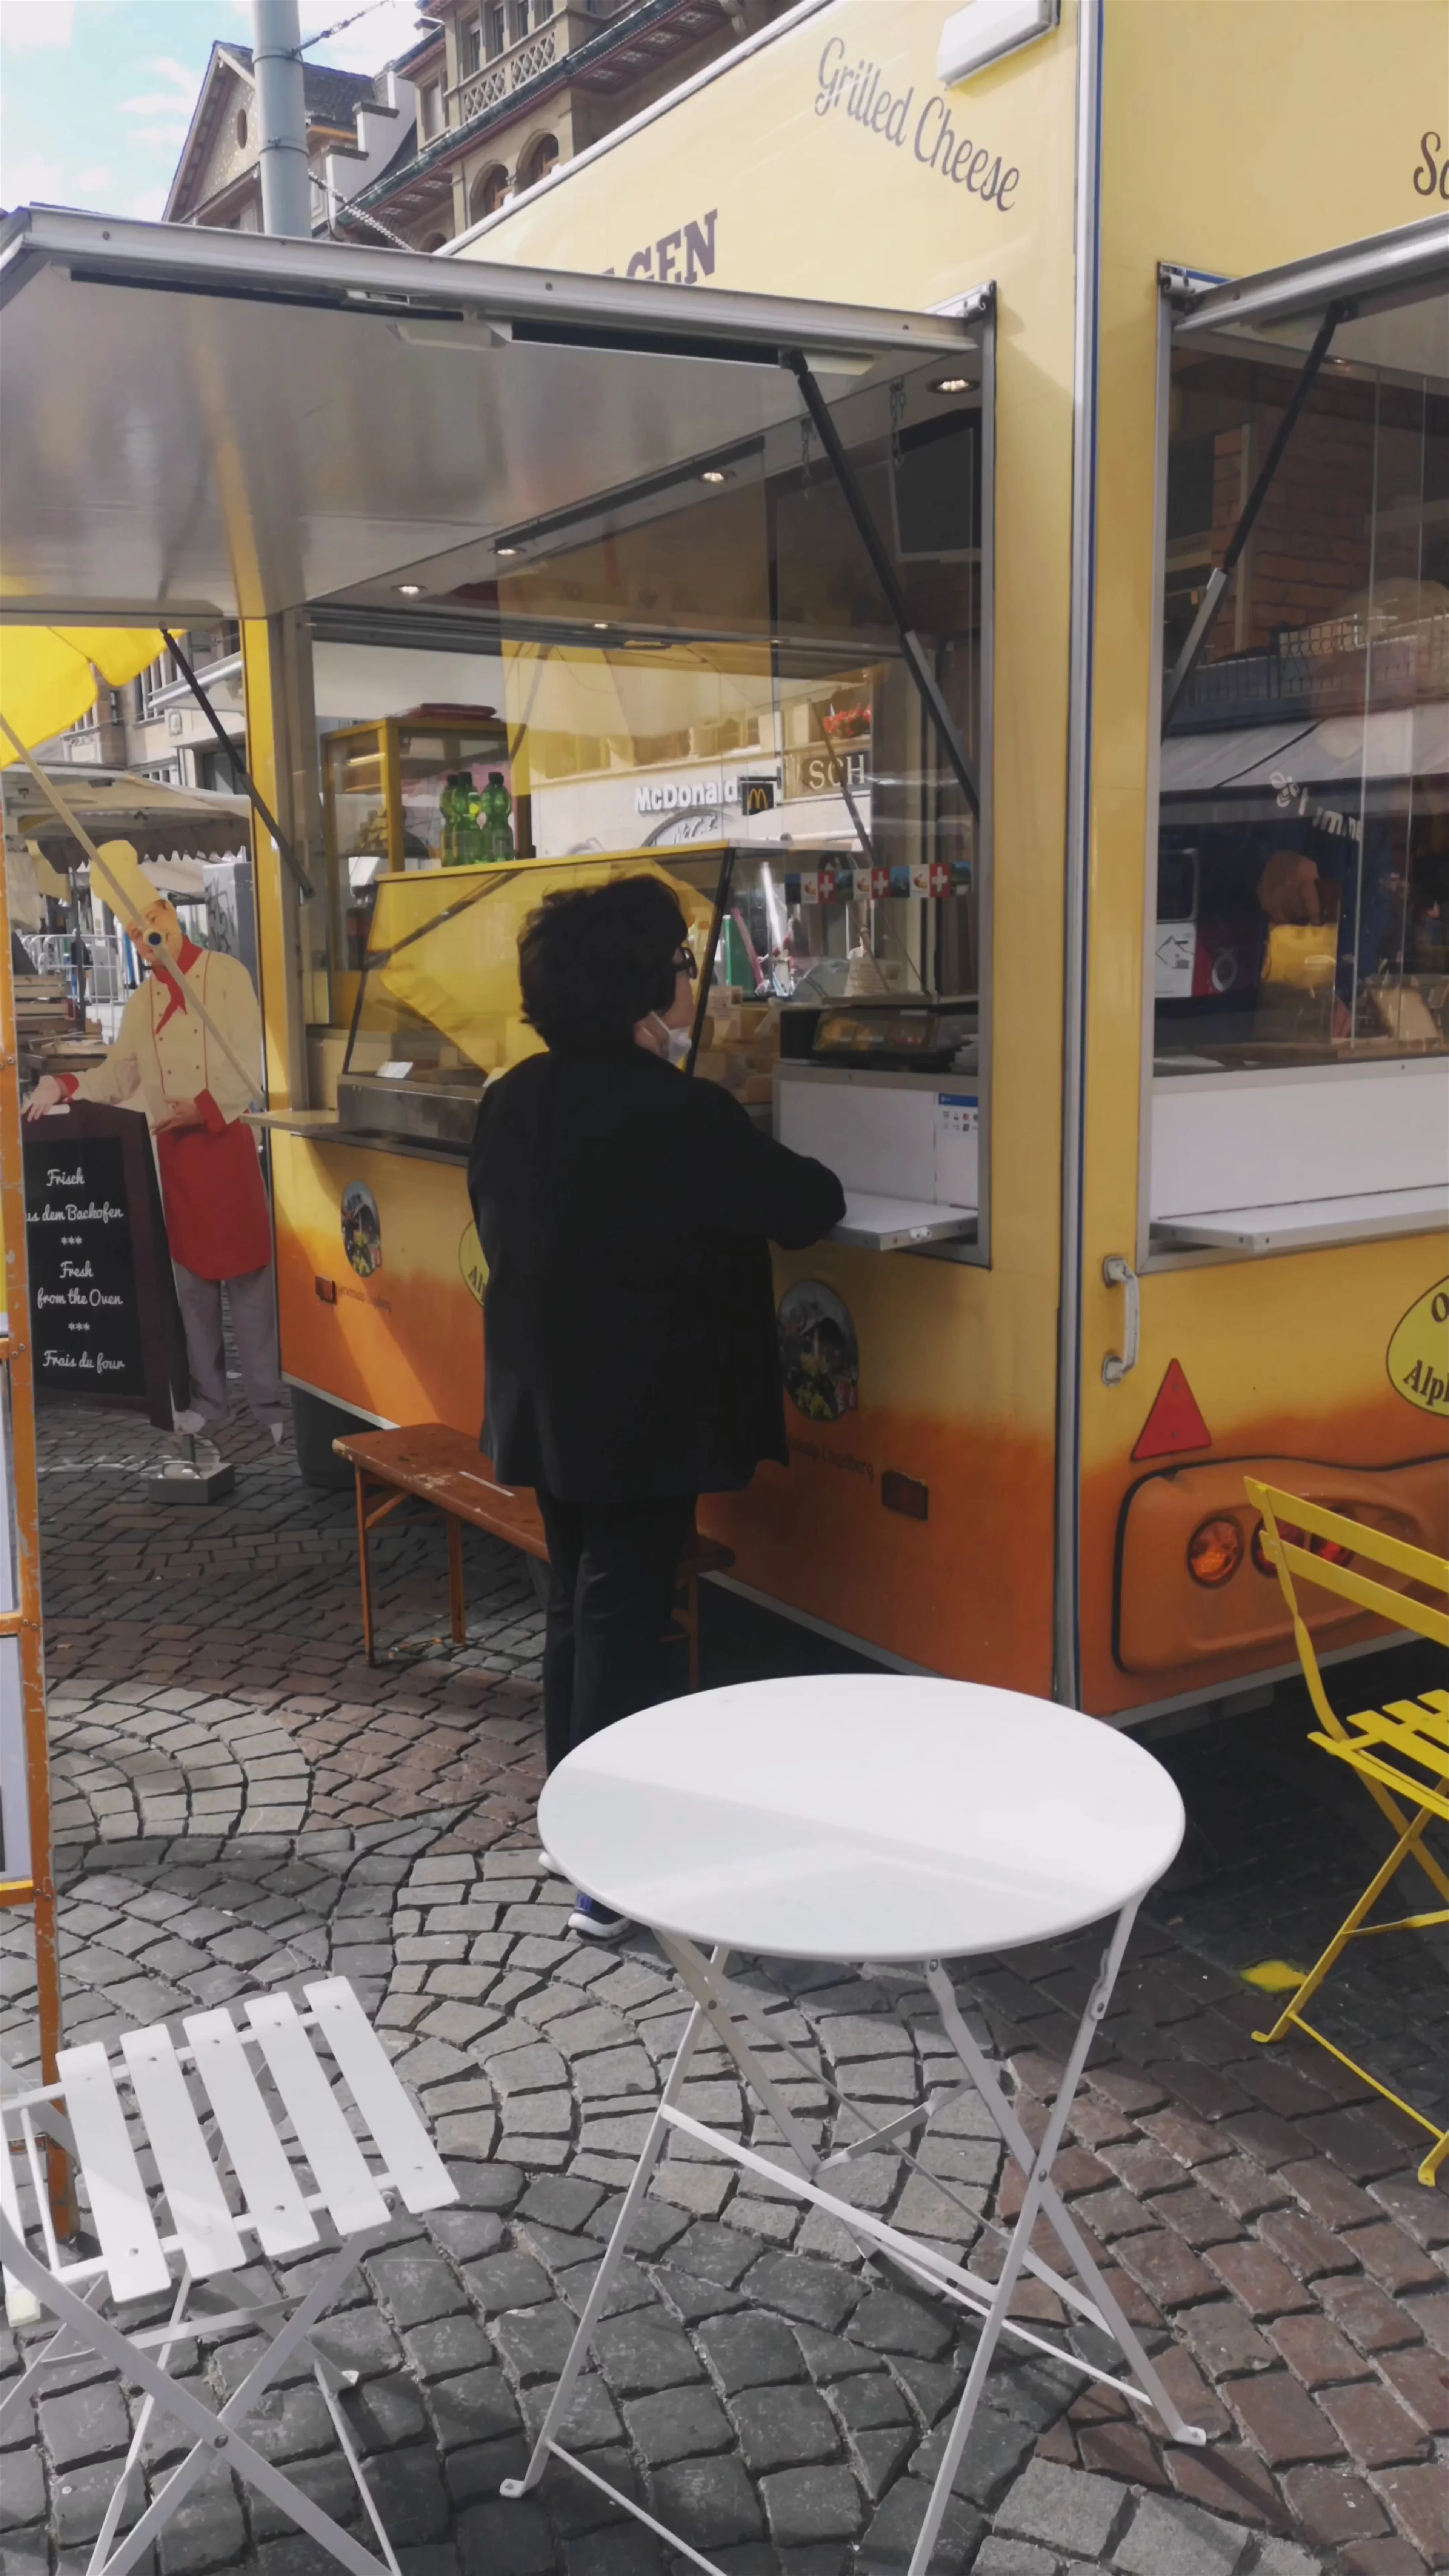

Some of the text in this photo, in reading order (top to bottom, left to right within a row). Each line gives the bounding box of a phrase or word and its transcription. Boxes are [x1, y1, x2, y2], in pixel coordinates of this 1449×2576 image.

[815, 37, 1020, 212] Grilled Cheese
[601, 208, 718, 285] GEN
[635, 776, 742, 812] McDonald
[46, 1167, 85, 1186] Frisch
[24, 1201, 124, 1224] us dem Backofen
[60, 1260, 94, 1278] Fresh
[37, 1287, 123, 1309] from the Oven
[43, 1350, 125, 1374] Frais du four
[1402, 1359, 1449, 1406] Alp
